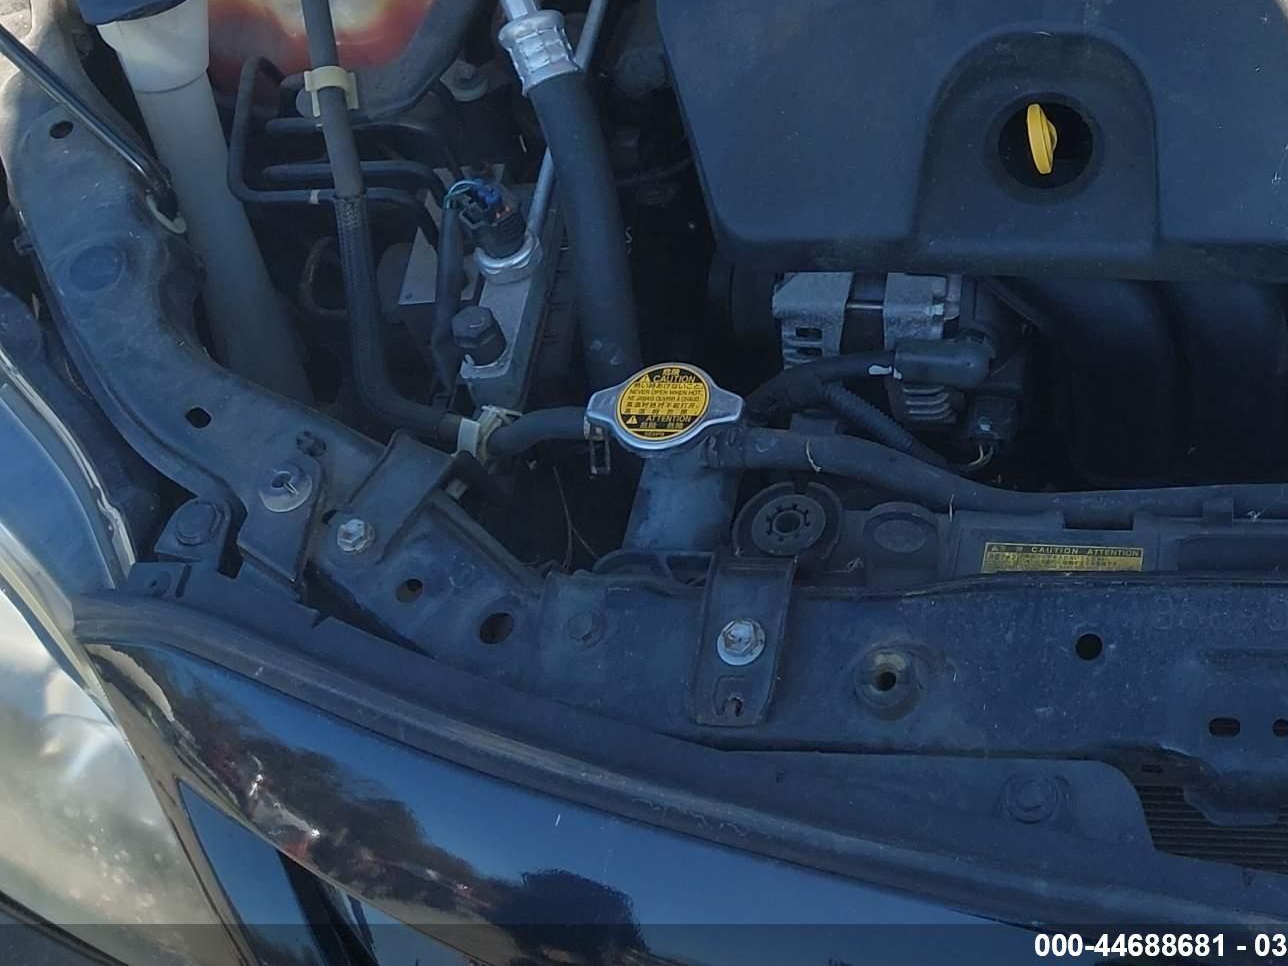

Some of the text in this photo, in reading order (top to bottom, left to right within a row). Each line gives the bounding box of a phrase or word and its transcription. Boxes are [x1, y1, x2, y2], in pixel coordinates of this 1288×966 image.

[653, 375, 696, 383] CAUTION
[1031, 545, 1079, 555] CAUTION
[1086, 548, 1140, 557] ATTENTION
